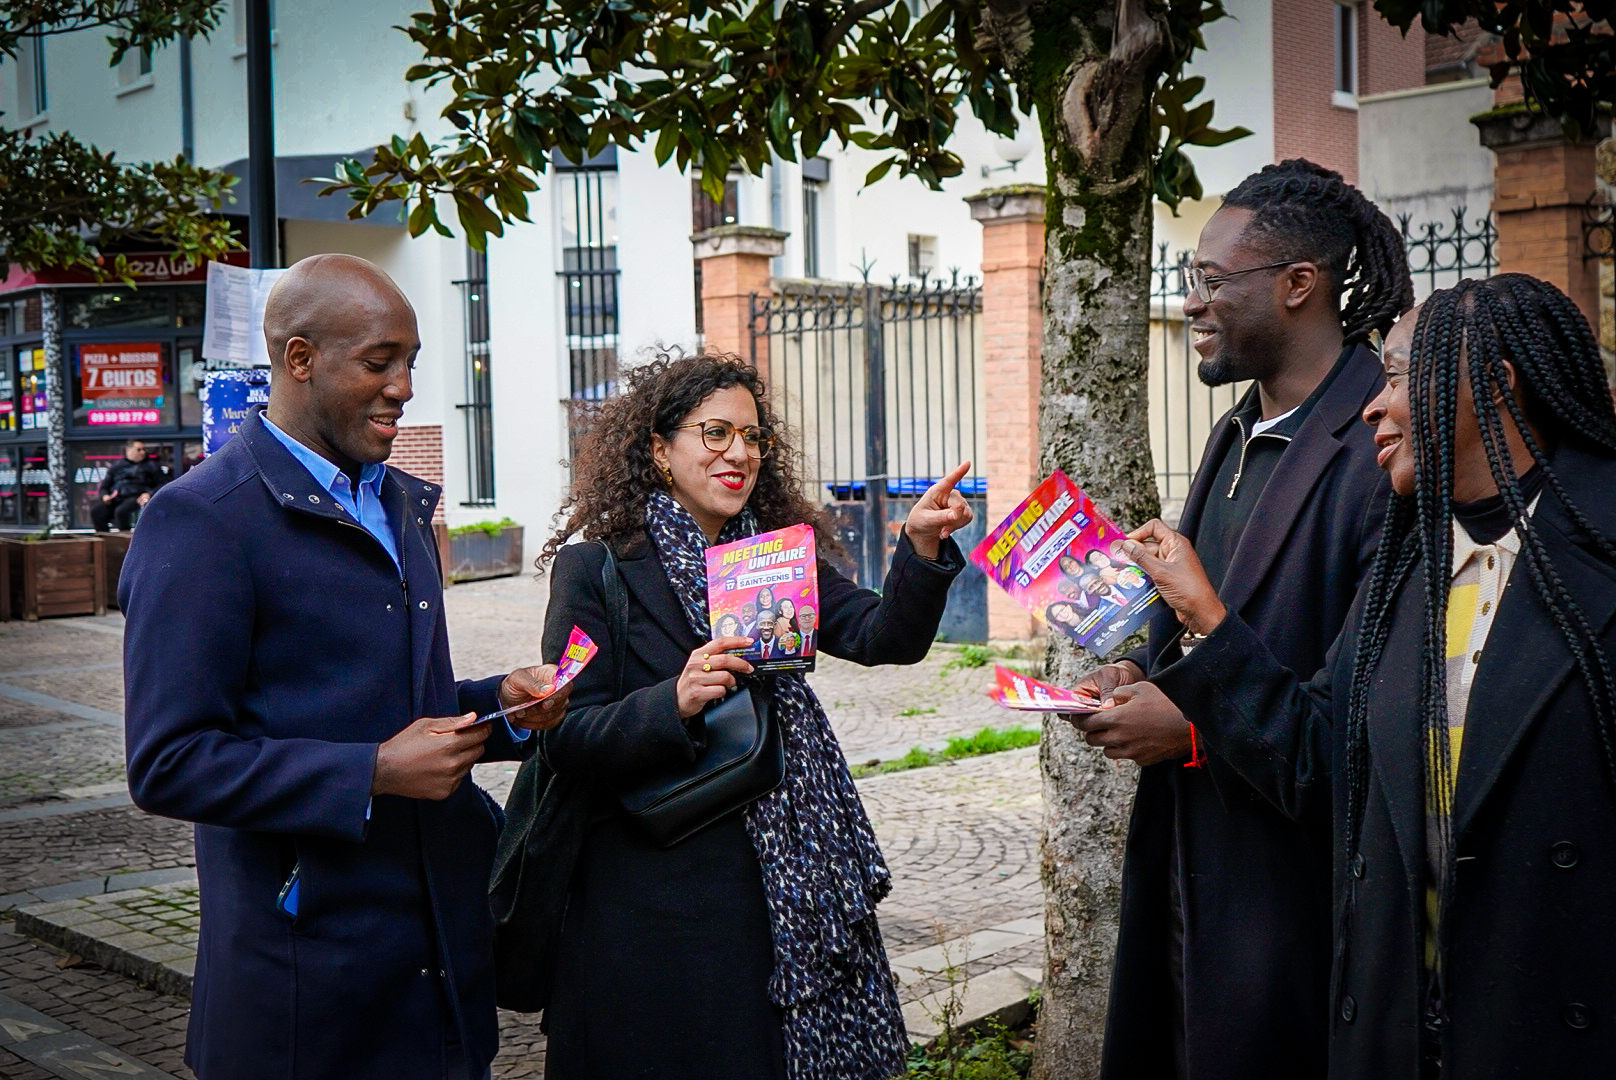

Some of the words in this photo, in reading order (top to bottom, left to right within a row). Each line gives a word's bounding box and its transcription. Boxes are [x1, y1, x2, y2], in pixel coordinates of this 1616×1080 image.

[84, 353, 109, 364] PIZZA
[86, 367, 99, 388] 7
[102, 368, 157, 388] euros
[987, 499, 1044, 567] MEETING
[1019, 490, 1075, 553] UNITAIRE
[722, 538, 783, 566] MEETING
[748, 546, 807, 570] UNITAIRE
[1030, 527, 1077, 575] SAINT-DENIS
[740, 573, 790, 588] SAINT-DENIS
